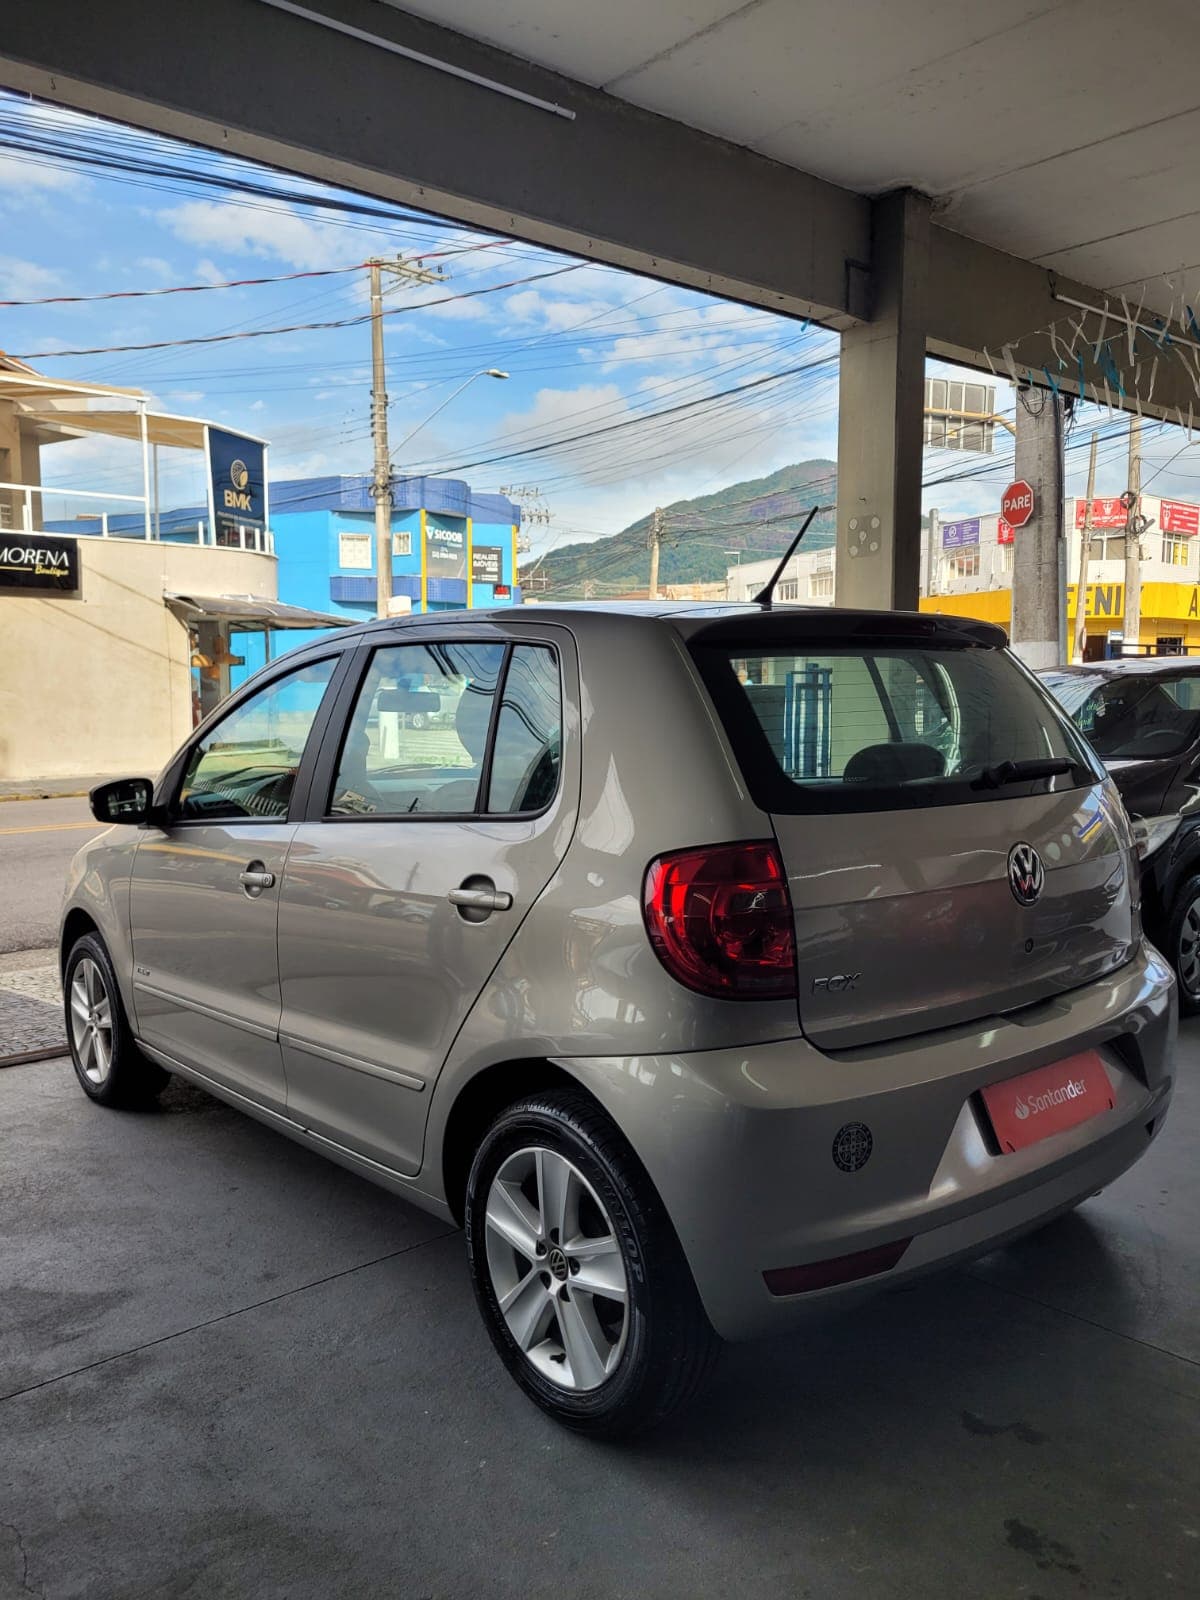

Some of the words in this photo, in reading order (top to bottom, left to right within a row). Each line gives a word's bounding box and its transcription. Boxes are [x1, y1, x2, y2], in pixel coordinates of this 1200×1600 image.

[223, 489, 253, 512] BMK
[1004, 493, 1031, 513] PARE
[434, 528, 463, 543] SICOOB
[812, 973, 863, 994] FOX
[1028, 1080, 1088, 1114] Santander
